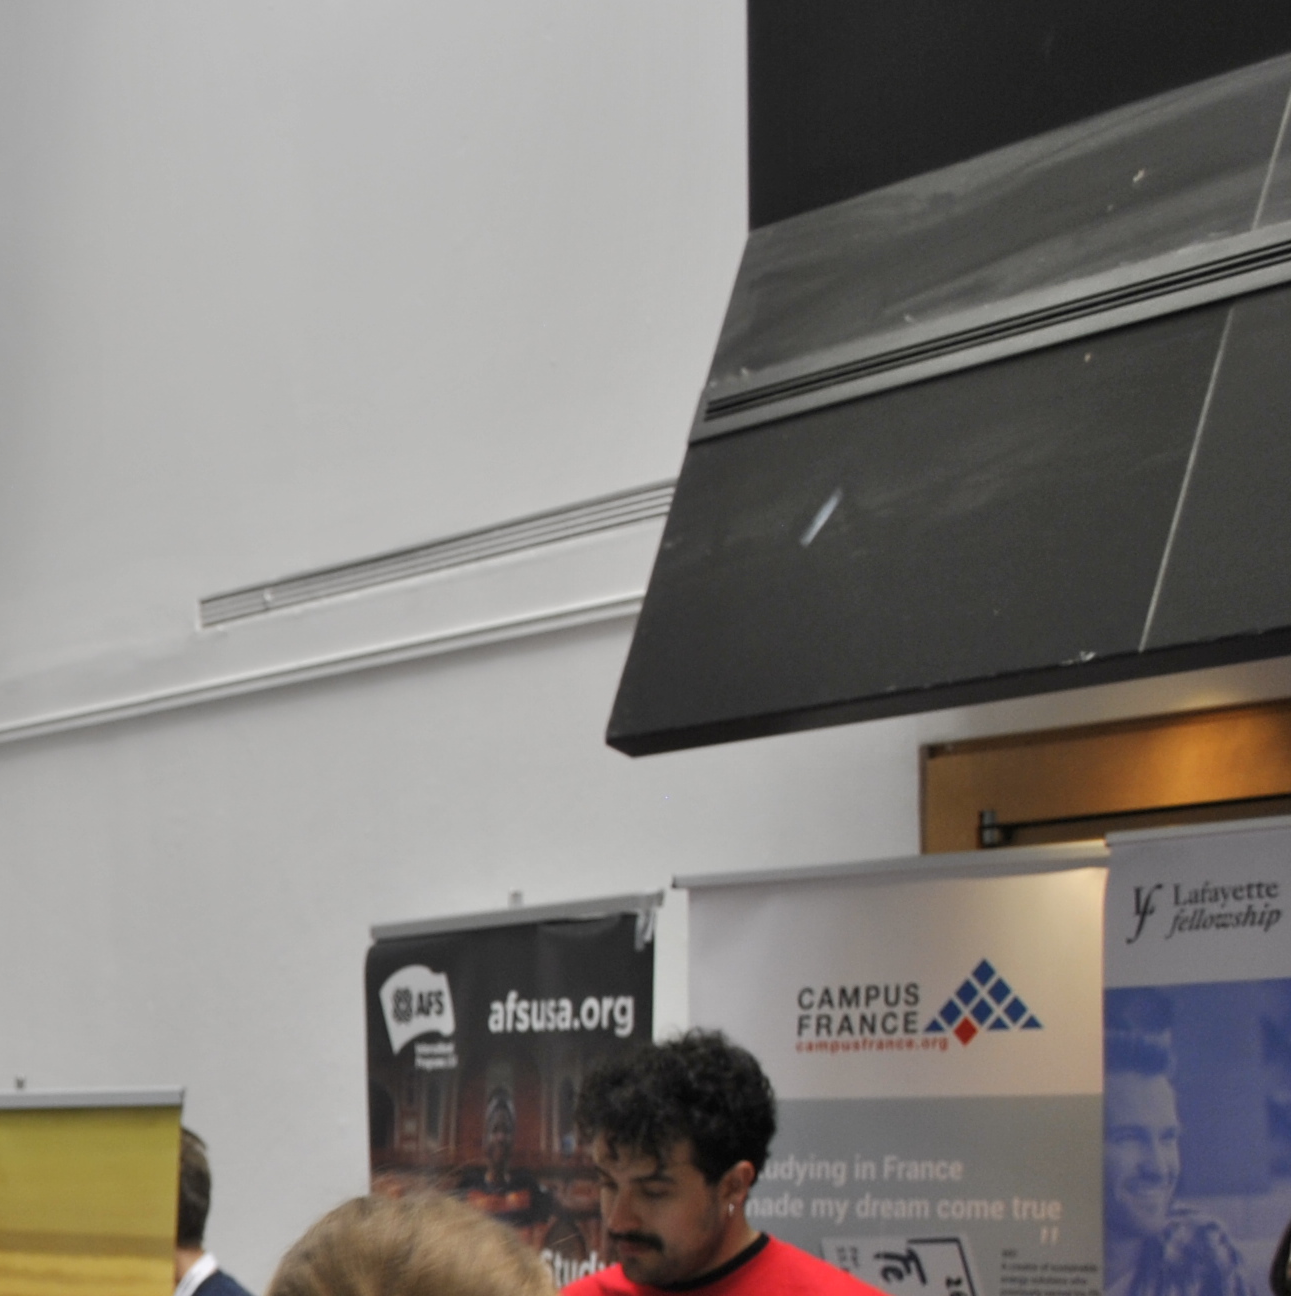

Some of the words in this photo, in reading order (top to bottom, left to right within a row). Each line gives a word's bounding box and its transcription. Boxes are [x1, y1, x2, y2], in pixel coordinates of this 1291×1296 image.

[1173, 881, 1280, 908] Lafayette
[1165, 903, 1283, 939] fellowship
[415, 989, 445, 1018] AFS
[796, 982, 920, 1010] CAMPUS
[487, 989, 635, 1038] afsusa.org
[796, 1011, 918, 1037] FRANCE
[795, 1036, 949, 1054] campusfrance.org
[759, 1156, 848, 1188] udying
[854, 1156, 876, 1181] in
[883, 1155, 965, 1181] France
[811, 1197, 850, 1224] my
[856, 1193, 931, 1220] dream
[936, 1199, 1006, 1221] come
[1012, 1195, 1064, 1221] true
